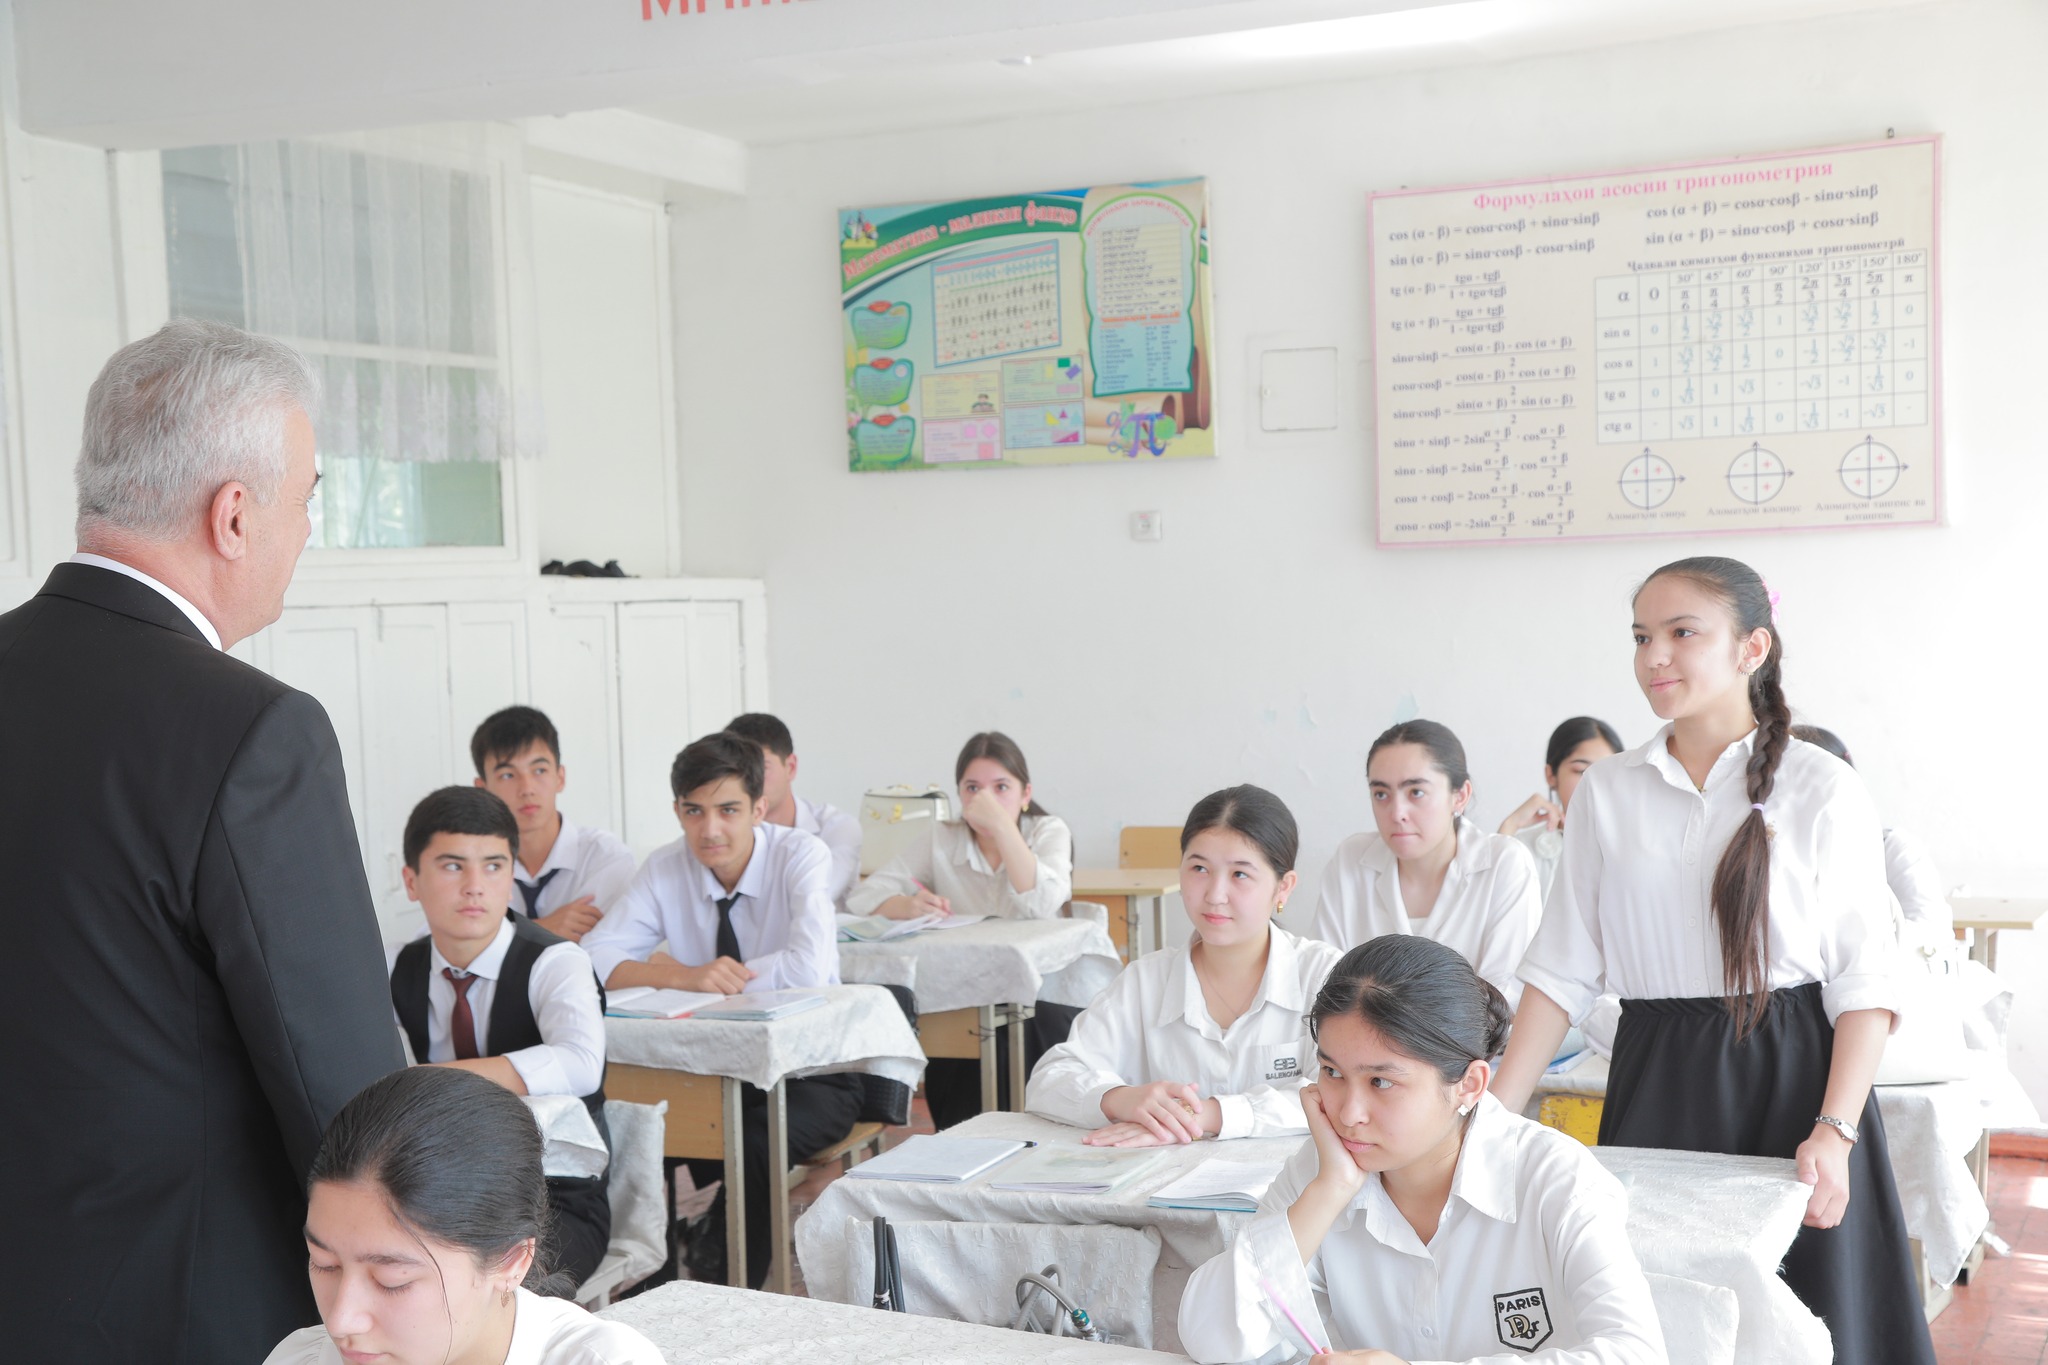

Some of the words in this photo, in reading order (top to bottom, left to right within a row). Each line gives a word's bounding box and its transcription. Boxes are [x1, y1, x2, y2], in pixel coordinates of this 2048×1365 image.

[1602, 180, 1667, 198] асосии
[1675, 162, 1833, 193] тригонометрия
[843, 224, 939, 282] Математика
[1497, 1295, 1541, 1313] PARIS
